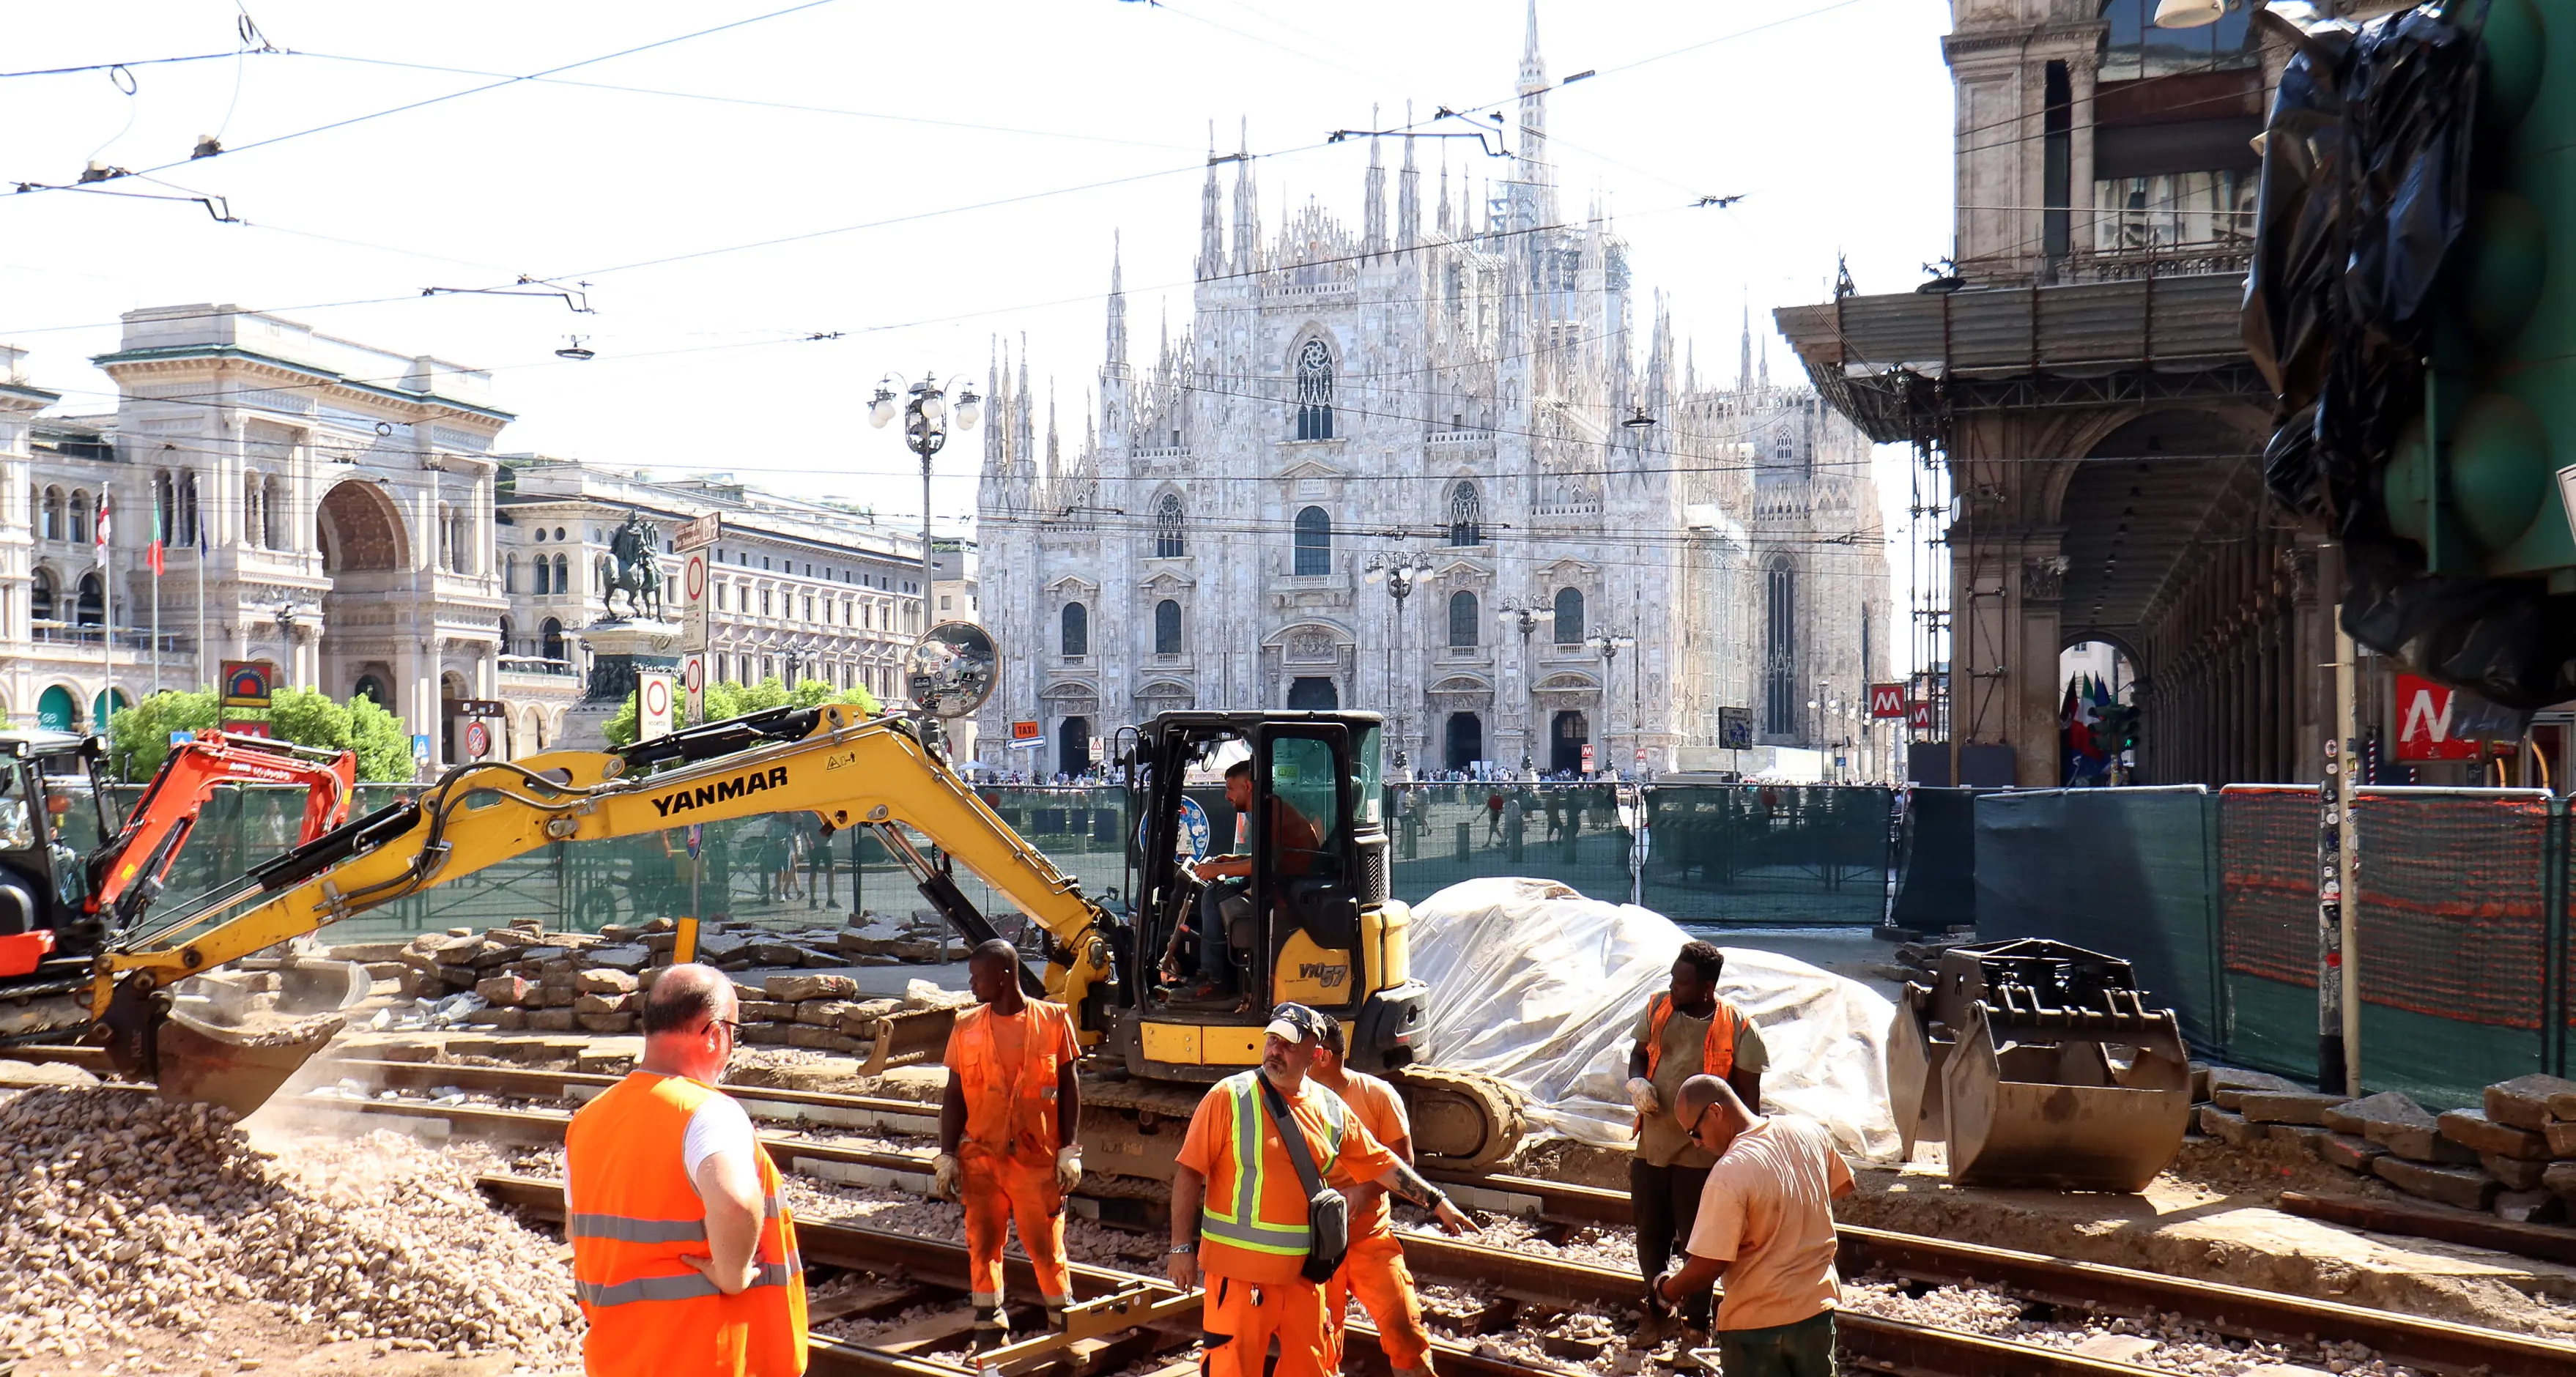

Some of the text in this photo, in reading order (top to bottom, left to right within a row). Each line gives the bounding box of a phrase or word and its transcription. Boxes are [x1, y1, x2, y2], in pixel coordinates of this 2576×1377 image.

[1874, 691, 1900, 710] M
[1018, 726, 1035, 735] TAXI
[651, 766, 788, 817] YANMAR
